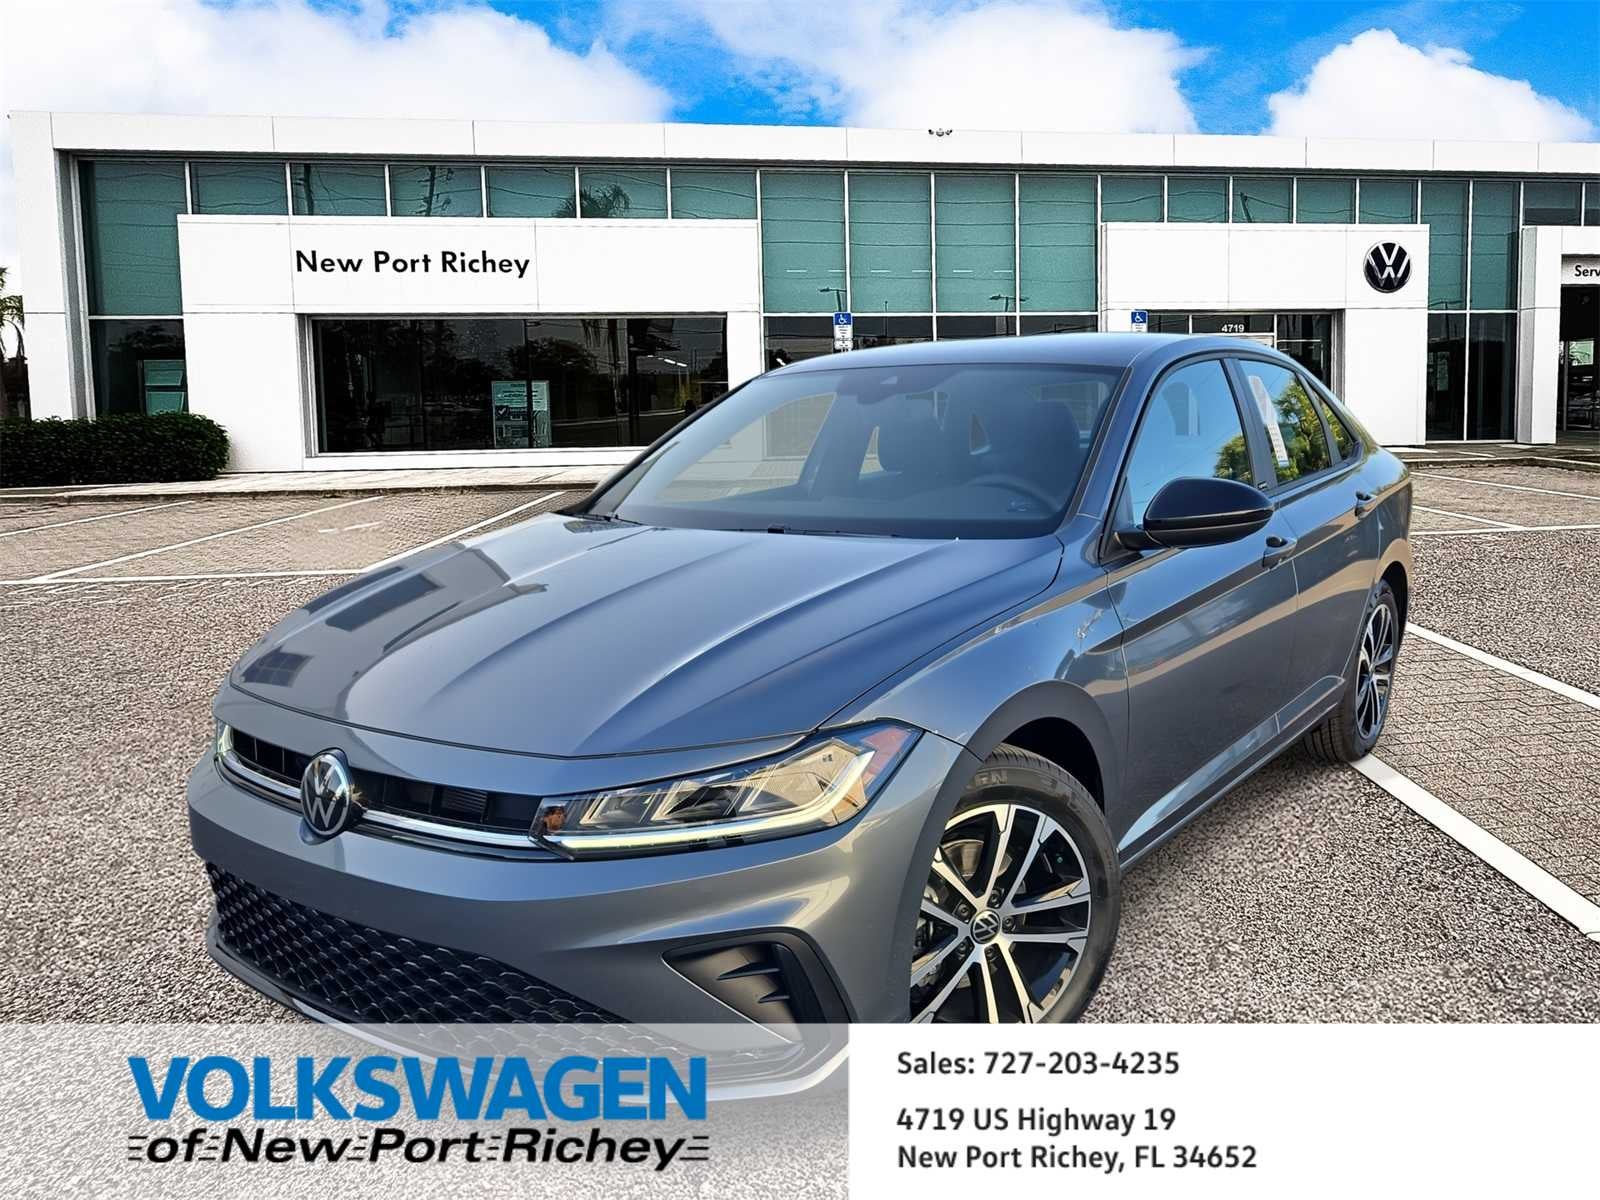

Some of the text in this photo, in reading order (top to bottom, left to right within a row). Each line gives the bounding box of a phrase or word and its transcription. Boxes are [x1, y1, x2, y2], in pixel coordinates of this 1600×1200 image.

[295, 250, 530, 279] New Port Richey
[1221, 324, 1245, 333] 4719
